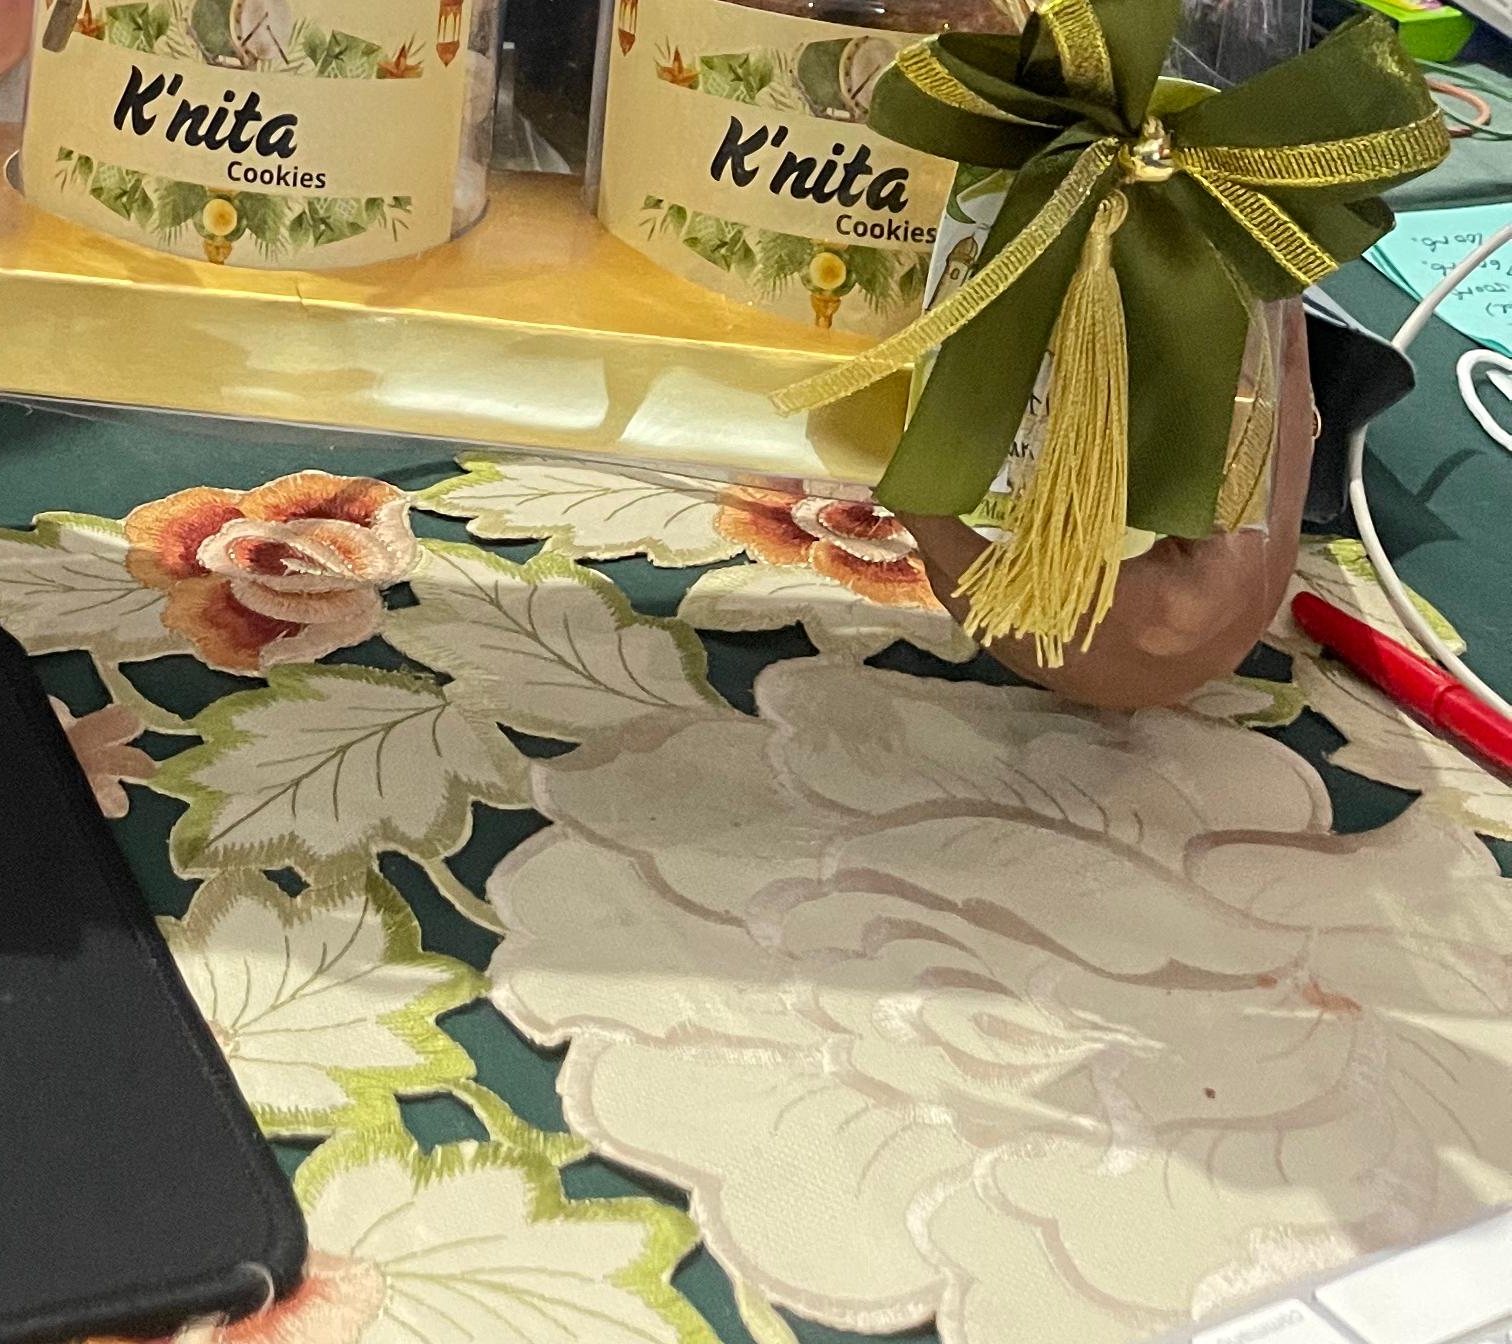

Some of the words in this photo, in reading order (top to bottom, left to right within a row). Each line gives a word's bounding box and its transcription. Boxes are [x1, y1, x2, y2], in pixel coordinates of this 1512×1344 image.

[113, 64, 299, 159] K'nita
[227, 160, 327, 189] Cookies
[710, 115, 910, 213] K'nita
[836, 214, 937, 244] Cookies
